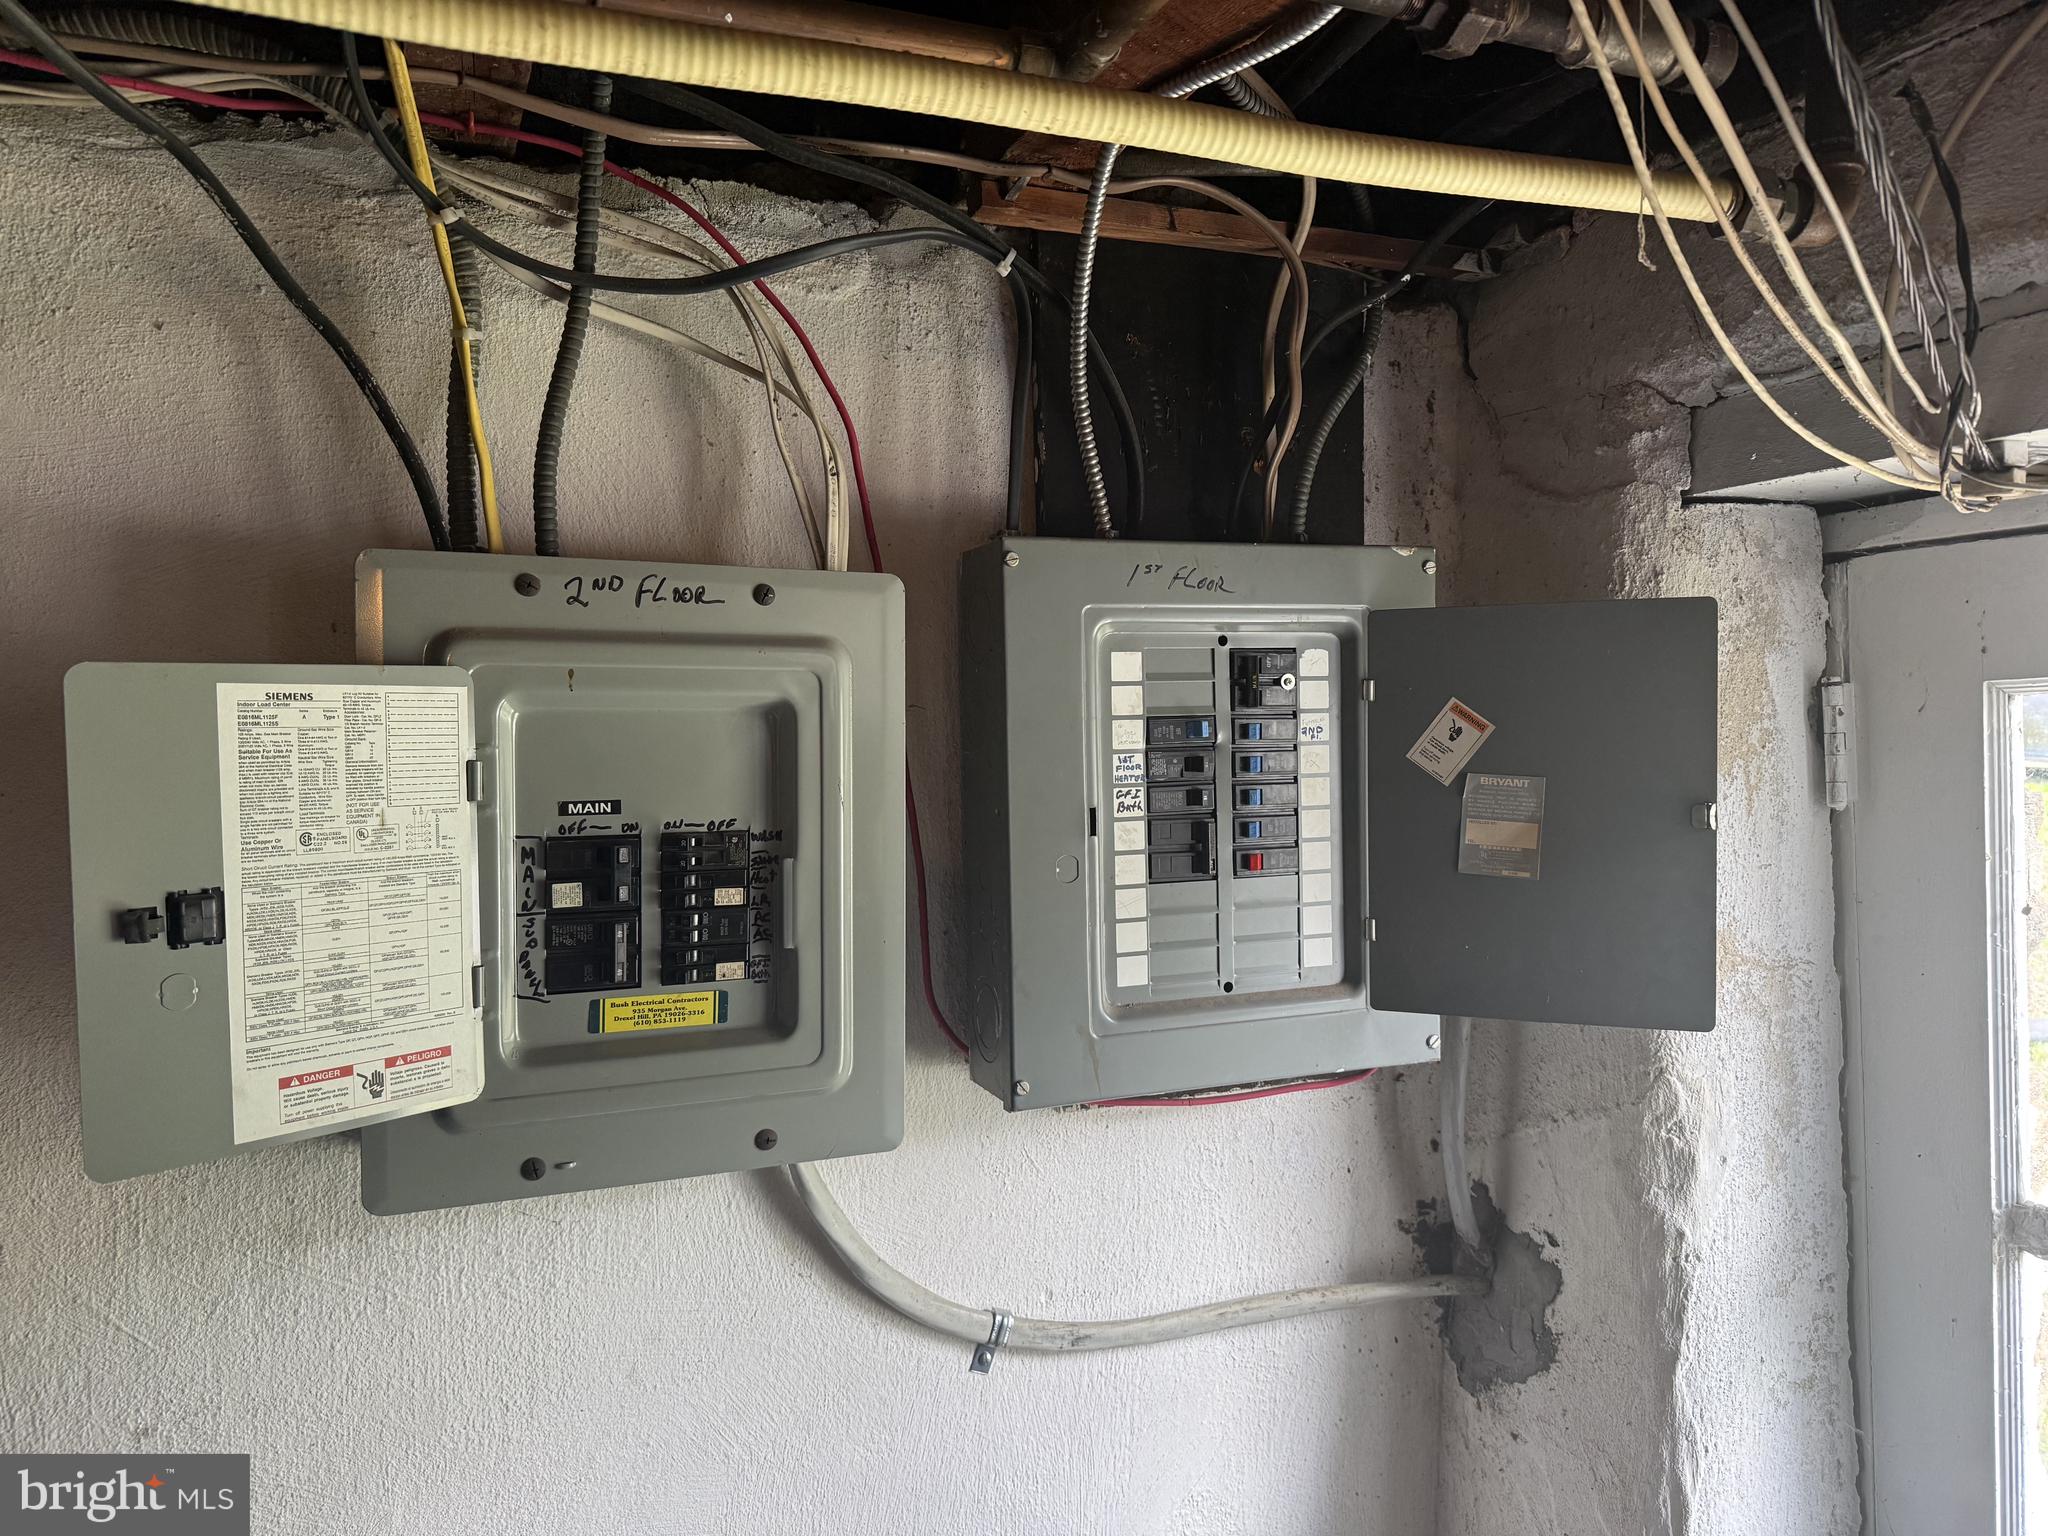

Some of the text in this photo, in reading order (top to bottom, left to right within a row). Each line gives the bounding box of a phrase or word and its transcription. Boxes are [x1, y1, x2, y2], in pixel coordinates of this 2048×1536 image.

[1167, 565, 1237, 594] FLOOR
[564, 573, 726, 609] 2ND FLOOR
[265, 691, 314, 701] SIEMENS
[1456, 707, 1487, 732] WARNING
[1480, 775, 1531, 788] BRYANT
[1115, 788, 1142, 800] GFI
[568, 802, 612, 815] MAIN
[558, 818, 588, 836] OFF
[610, 995, 709, 1009] Bush Electrical Contractors
[647, 1005, 672, 1014] Morgan
[613, 1014, 636, 1022] Drexel
[633, 1016, 687, 1027] (610) 853-1119
[406, 1049, 442, 1063] PELIGRO
[303, 1070, 341, 1083] DANGER
